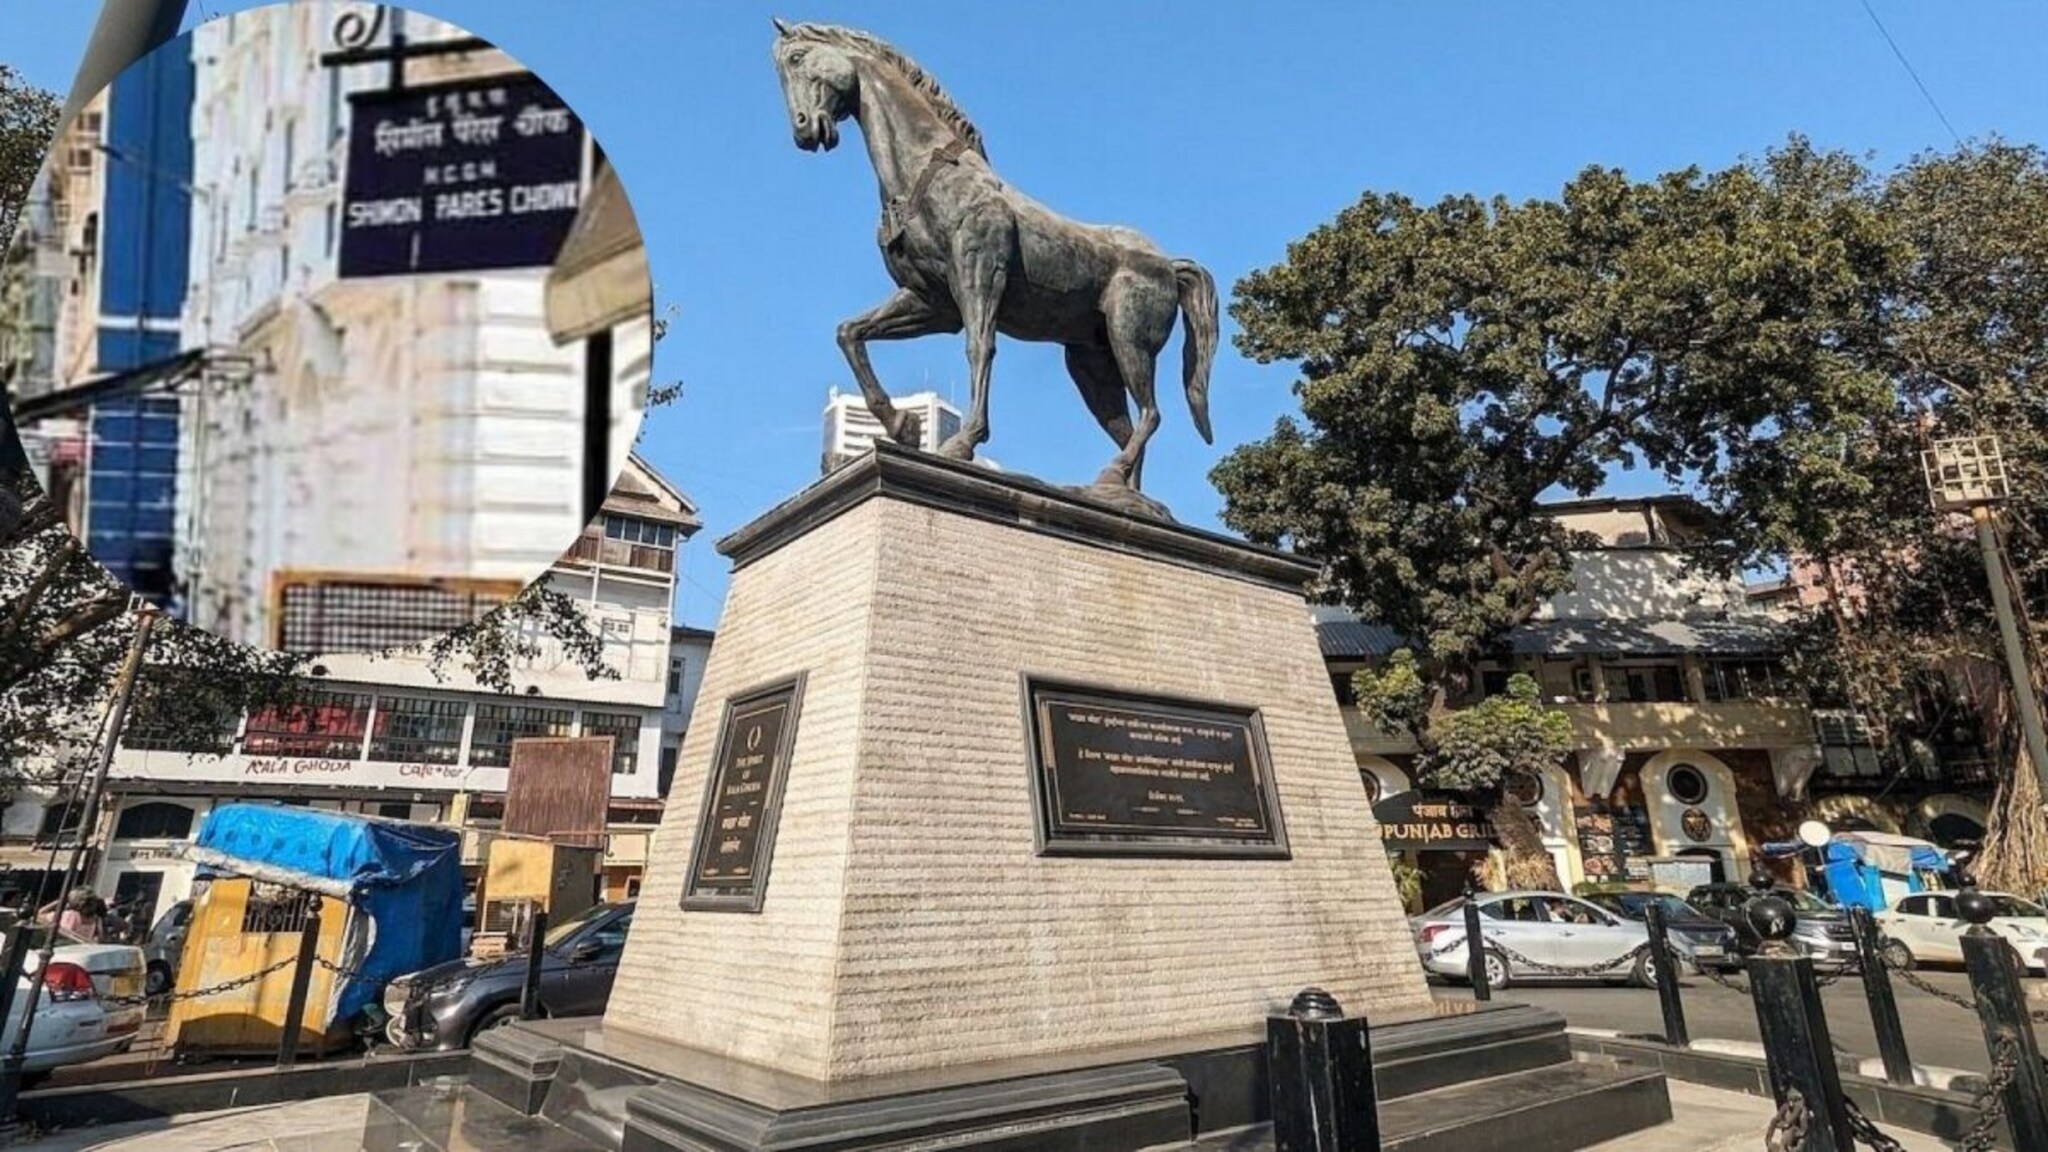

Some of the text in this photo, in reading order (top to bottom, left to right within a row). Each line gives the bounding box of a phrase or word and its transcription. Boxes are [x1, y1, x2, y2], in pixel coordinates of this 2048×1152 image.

[349, 197, 422, 228] SHIMON
[435, 188, 503, 220] PARES
[245, 760, 288, 774] KALA
[294, 760, 351, 774] GHODA
[1384, 823, 1452, 844] PUNJAB
